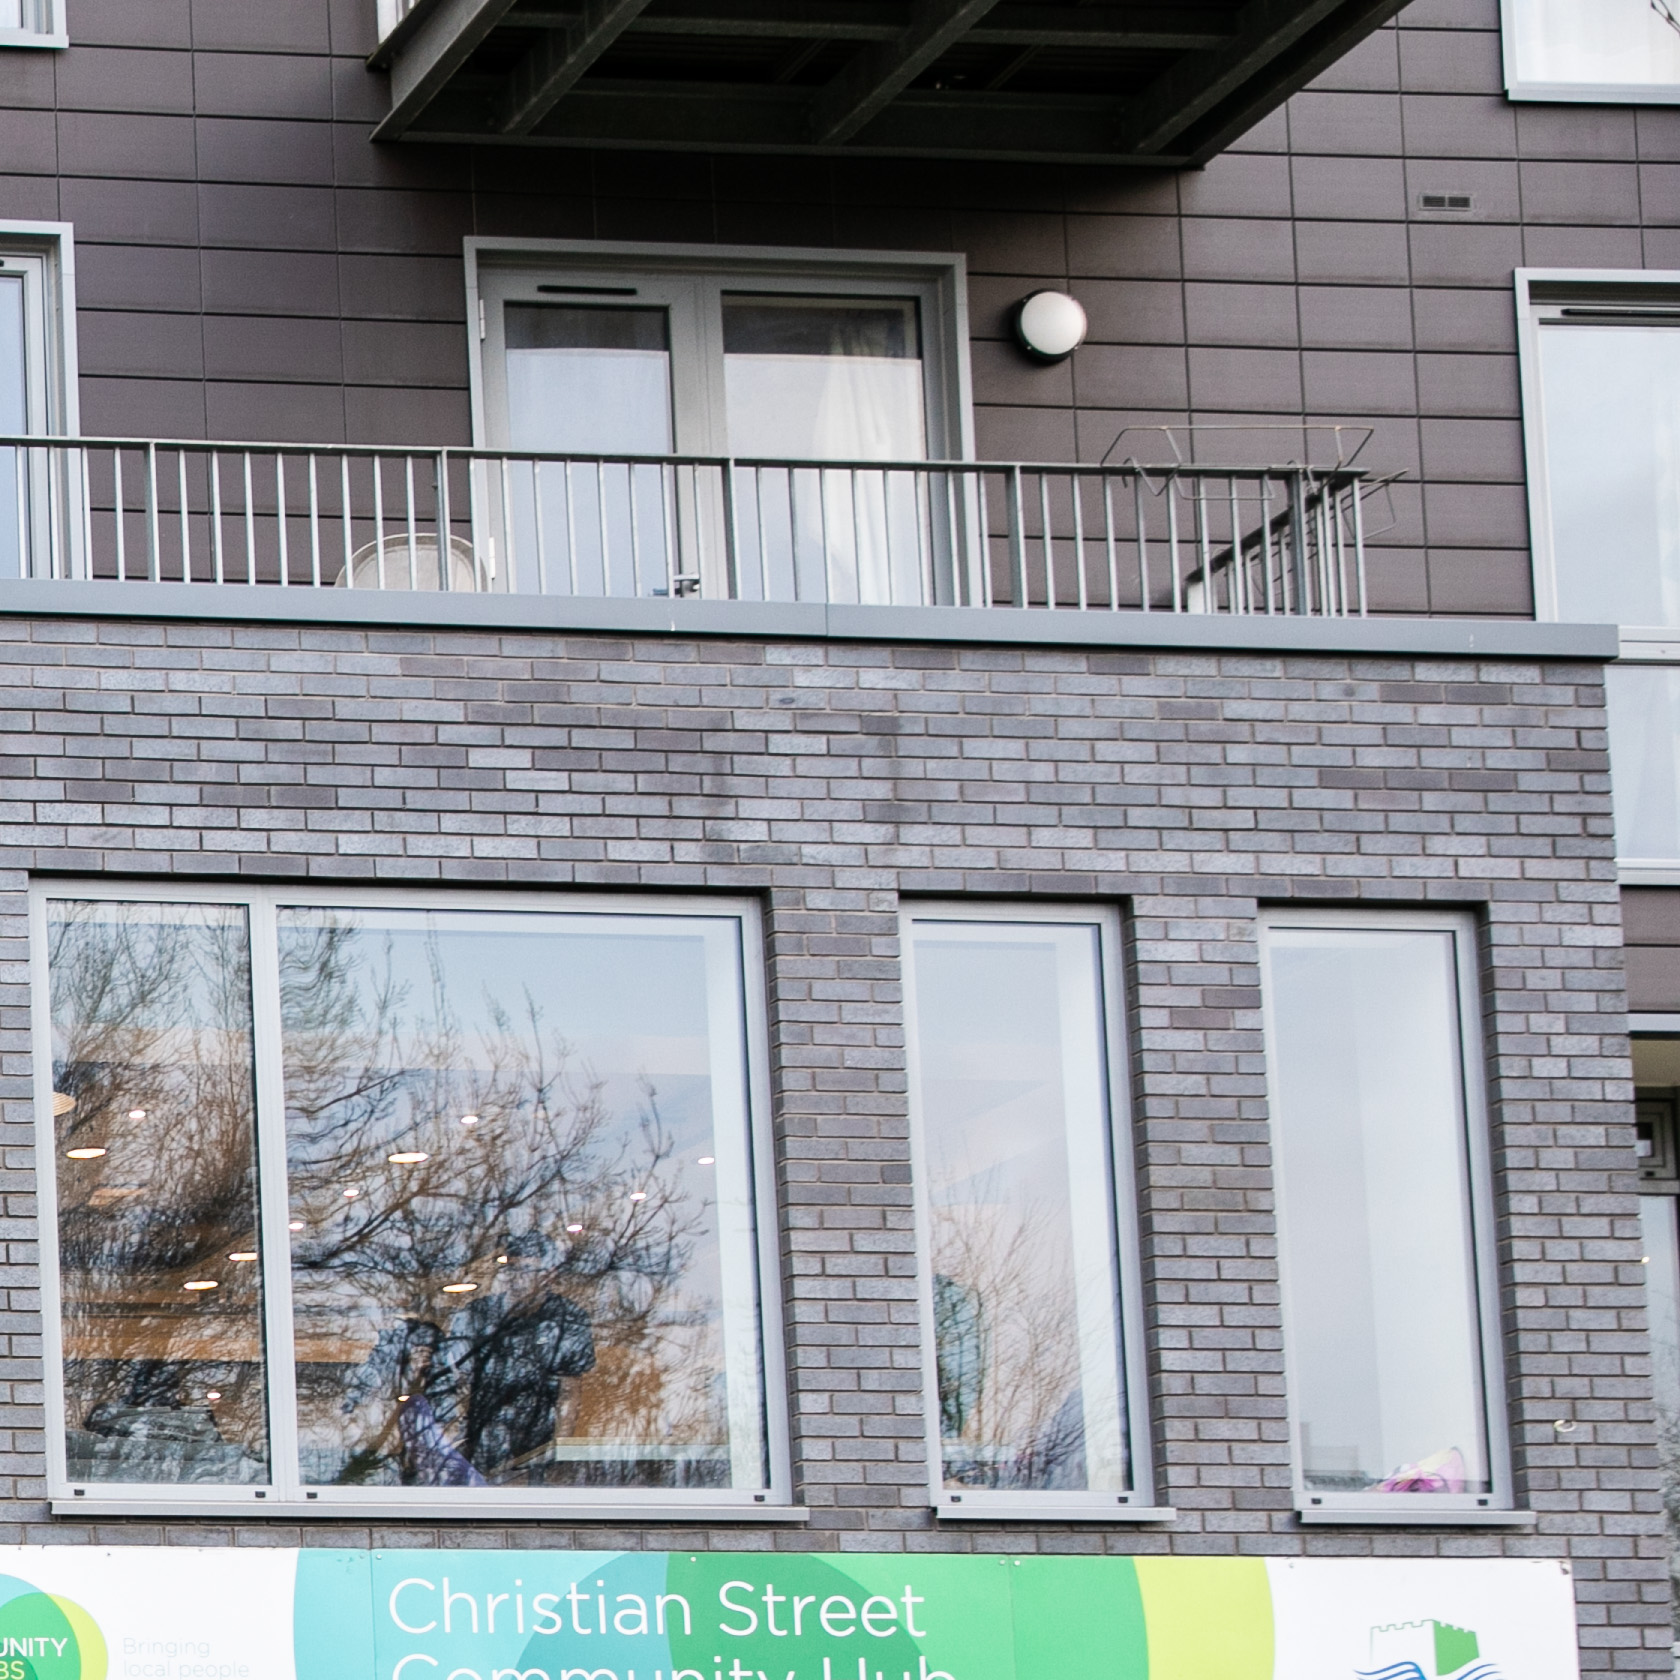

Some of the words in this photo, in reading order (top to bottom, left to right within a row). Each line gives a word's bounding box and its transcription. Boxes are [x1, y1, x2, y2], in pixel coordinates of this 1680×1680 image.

[388, 1576, 692, 1636] Christian
[718, 1580, 927, 1638] Street
[122, 1637, 210, 1658] Bringing
[123, 1660, 170, 1678] local
[179, 1660, 249, 1680] people
